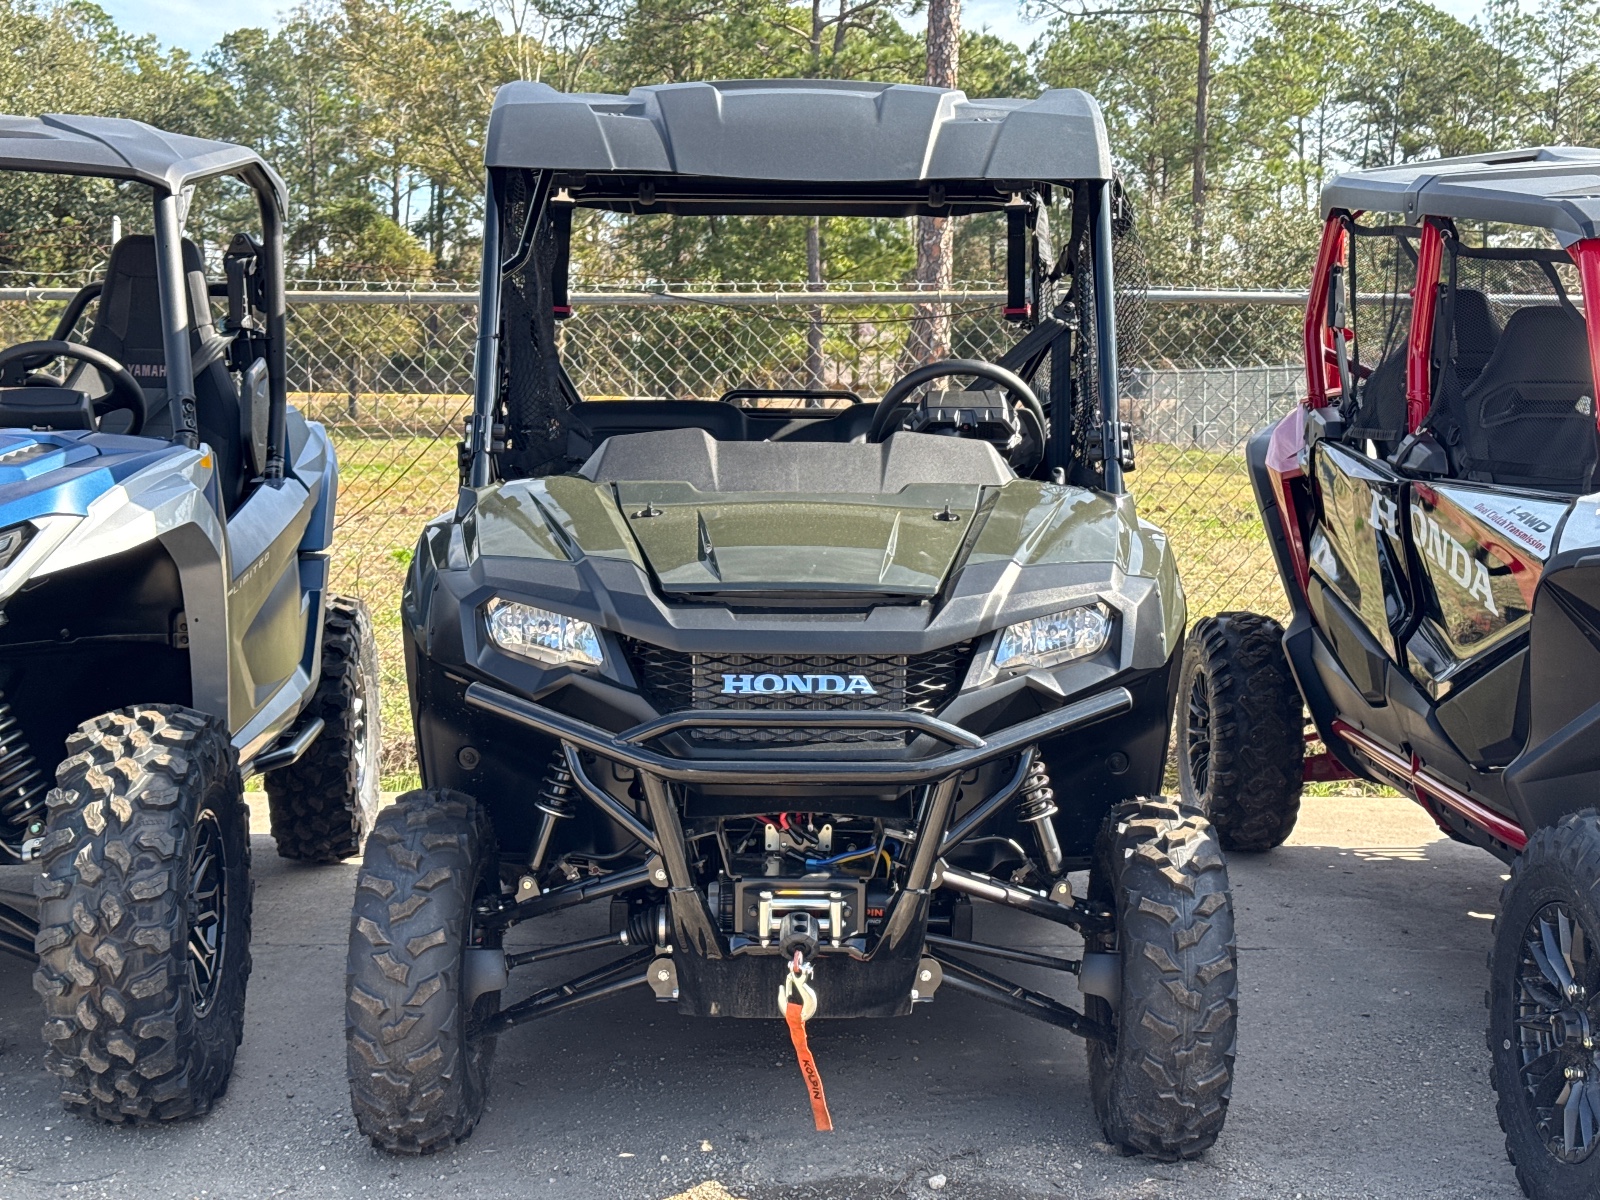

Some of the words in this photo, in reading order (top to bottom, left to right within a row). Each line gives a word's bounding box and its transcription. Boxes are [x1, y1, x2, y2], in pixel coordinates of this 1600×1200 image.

[127, 364, 167, 377] YAMAH
[1474, 503, 1490, 515] Dual
[1487, 511, 1506, 527] Clutch
[1505, 521, 1546, 552] Transmission
[1506, 506, 1552, 533] i-4WD
[233, 551, 270, 595] LIMITED
[1367, 489, 1499, 618] HONDA
[721, 673, 878, 694] HONDA
[802, 1060, 821, 1099] KOLPIN
